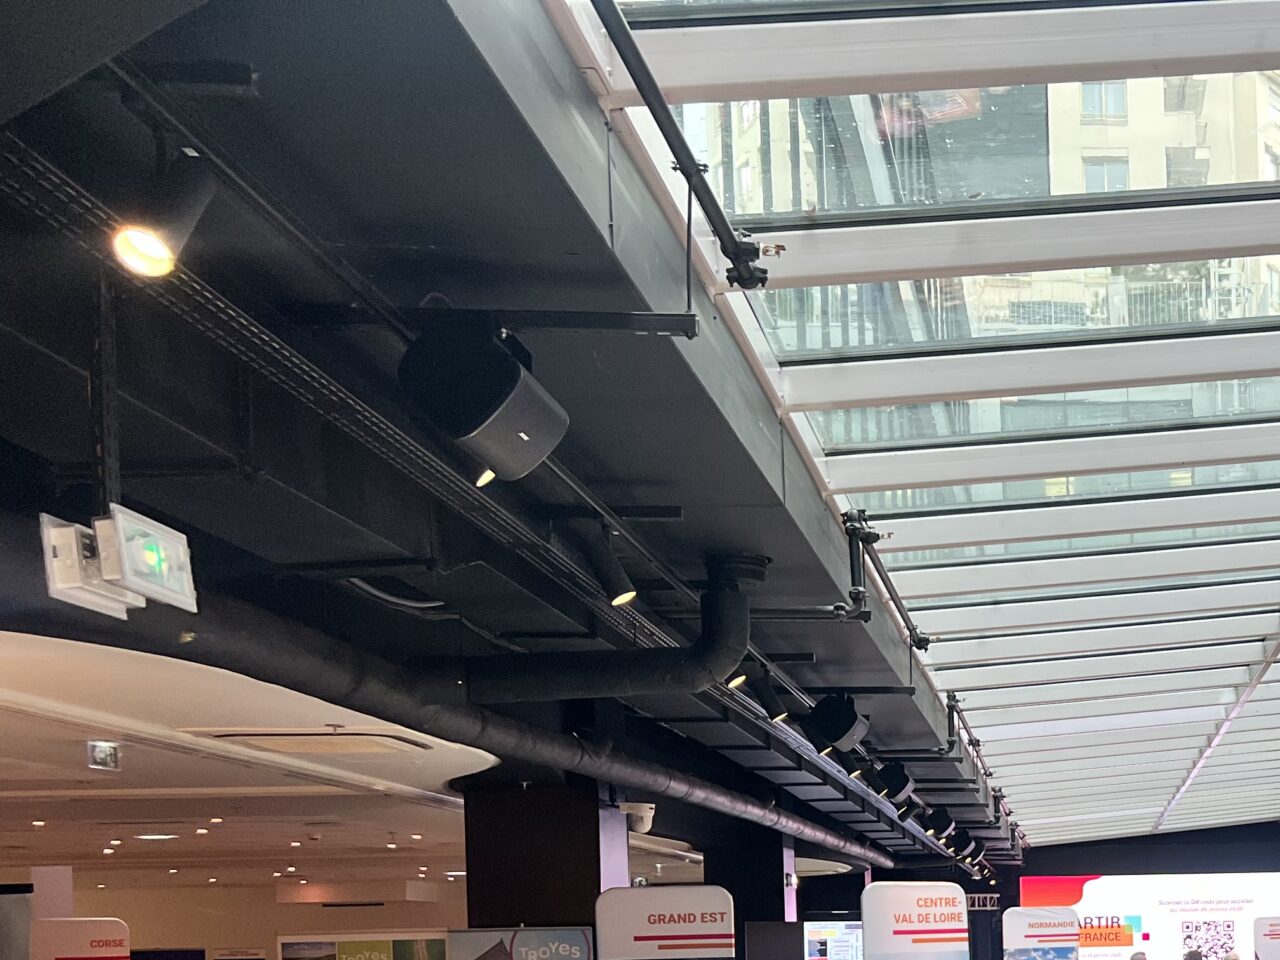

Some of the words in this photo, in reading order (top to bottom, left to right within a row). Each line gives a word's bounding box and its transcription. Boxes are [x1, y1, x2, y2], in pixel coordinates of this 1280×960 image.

[916, 897, 961, 908] CENTRE-
[647, 913, 697, 925] GRAND
[700, 912, 727, 923] EST
[893, 914, 914, 924] VAL
[917, 913, 931, 923] DE
[934, 912, 964, 923] LOIRE
[1028, 921, 1075, 929] NORMANDIE
[1079, 931, 1122, 942] FRANCE
[90, 939, 126, 948] CORSE
